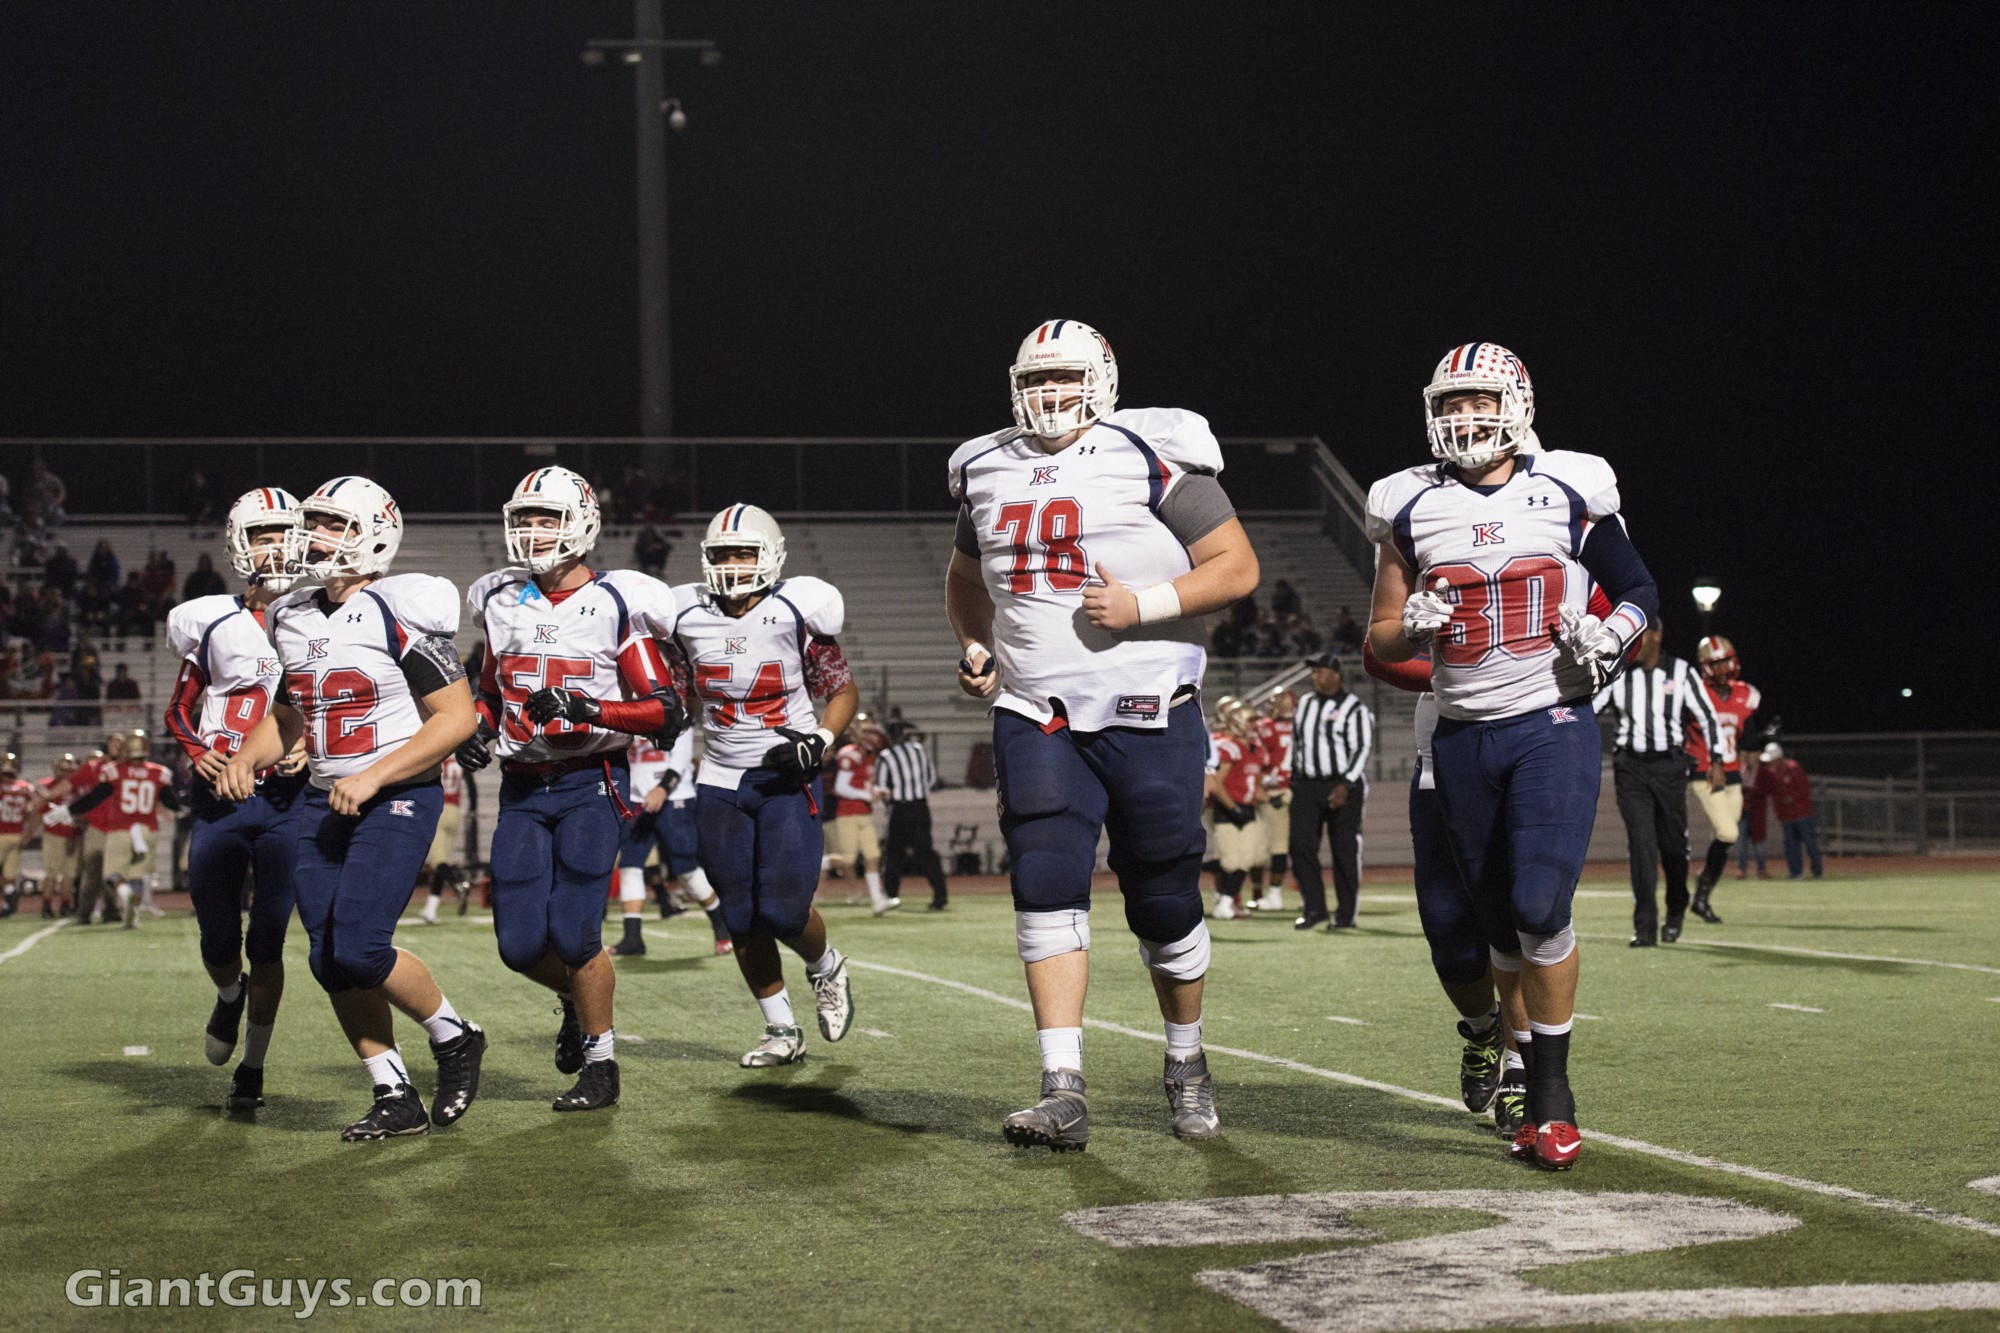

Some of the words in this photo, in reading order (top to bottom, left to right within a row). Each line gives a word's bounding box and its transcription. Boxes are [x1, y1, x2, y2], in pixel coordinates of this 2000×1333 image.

[1030, 466, 1059, 486] K
[1473, 521, 1505, 546] K
[992, 496, 1089, 594] 78
[1422, 554, 1567, 668] 80
[534, 624, 558, 644] K
[307, 638, 329, 660] K
[725, 637, 747, 654] K
[256, 658, 281, 676] K
[499, 651, 594, 749] 55
[694, 660, 791, 729] 54
[1548, 707, 1579, 724] K
[121, 779, 156, 814] 50
[389, 799, 415, 817] K
